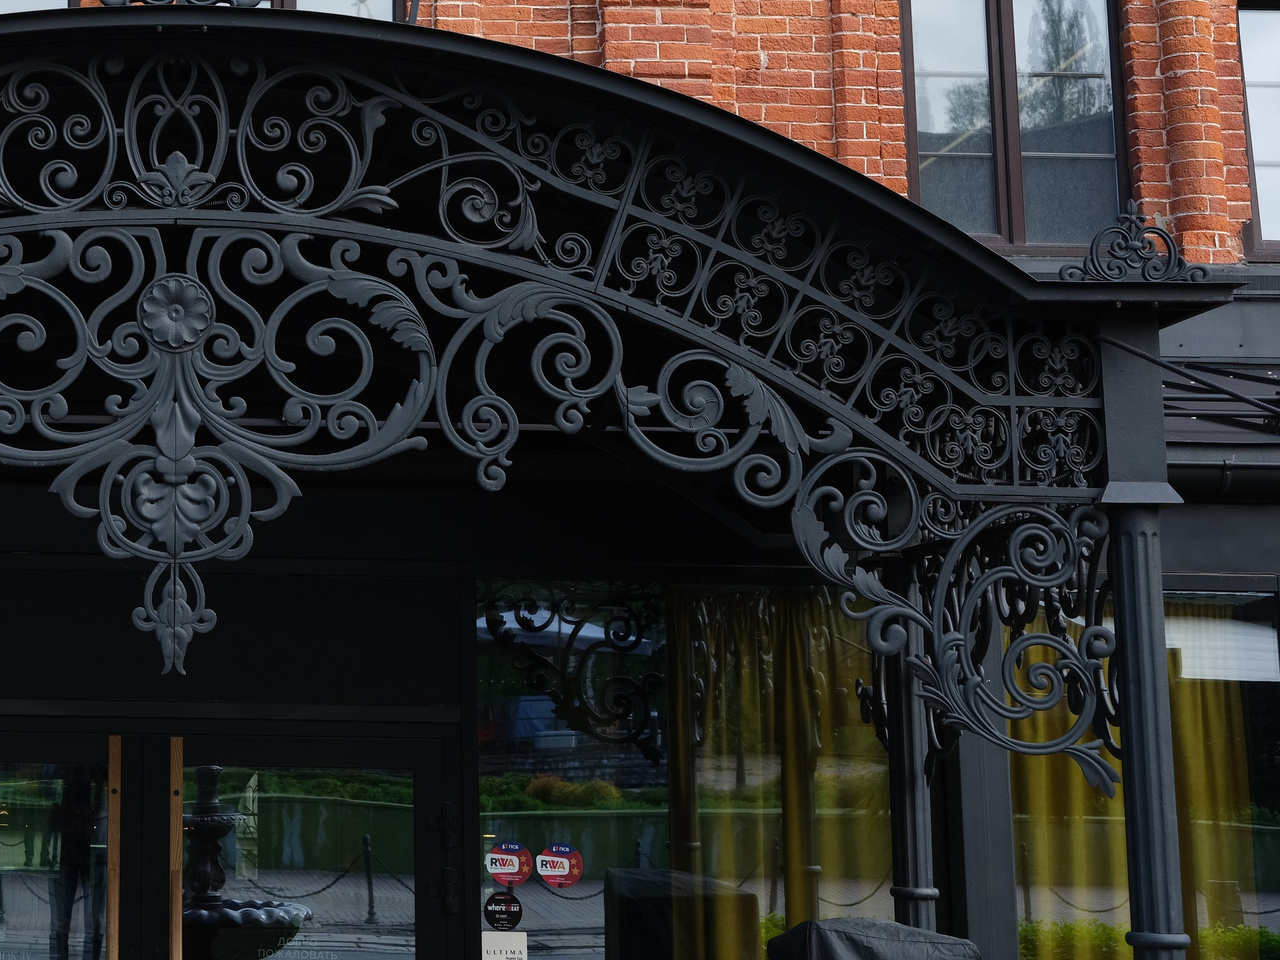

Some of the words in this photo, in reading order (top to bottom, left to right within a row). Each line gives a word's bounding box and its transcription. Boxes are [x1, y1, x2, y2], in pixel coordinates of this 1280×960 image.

[490, 857, 515, 868] RWA
[540, 859, 566, 870] RWA
[277, 937, 318, 947] ДОБРО
[258, 949, 338, 960] ПОЖАЛОВАТЬ
